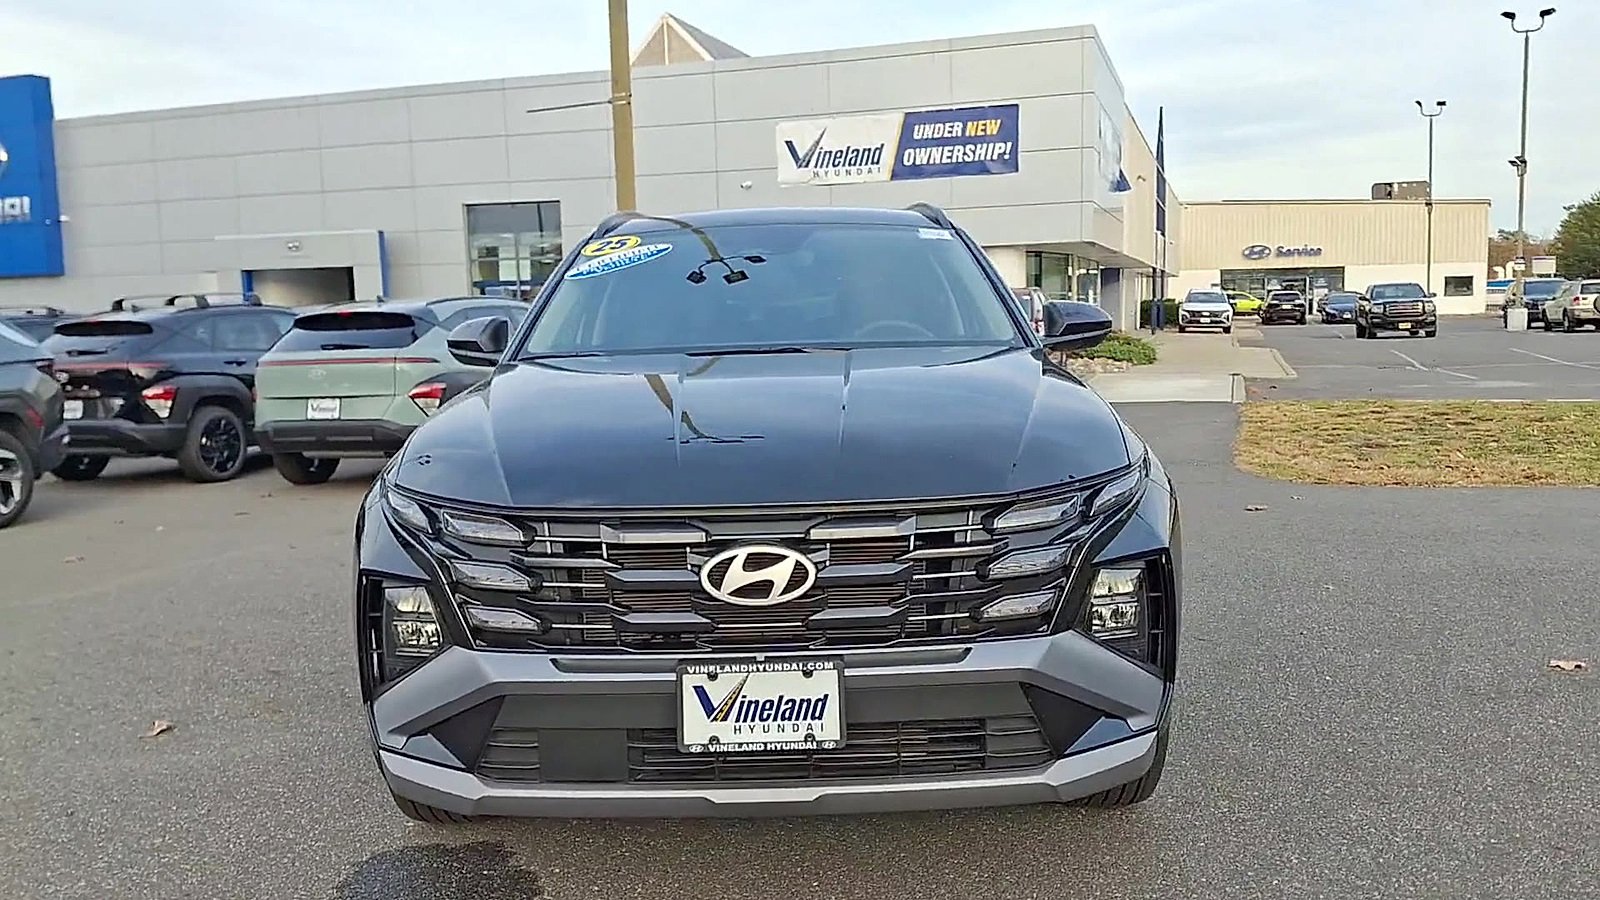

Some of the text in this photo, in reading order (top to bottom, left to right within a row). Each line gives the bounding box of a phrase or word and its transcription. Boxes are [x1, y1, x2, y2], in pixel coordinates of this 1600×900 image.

[914, 119, 1001, 139] UNDER NEW
[784, 127, 885, 169] Vineland
[903, 142, 1013, 166] OWNERSHIP!
[813, 167, 881, 178] HYUNDAI
[591, 238, 631, 253] 25
[1276, 244, 1322, 257] Service
[687, 662, 834, 675] VINELANDHYUNDAI.COM
[692, 673, 829, 723] Vineland
[733, 723, 824, 735] HYUNDAI
[708, 742, 817, 752] VINELAND HYUNDAI
